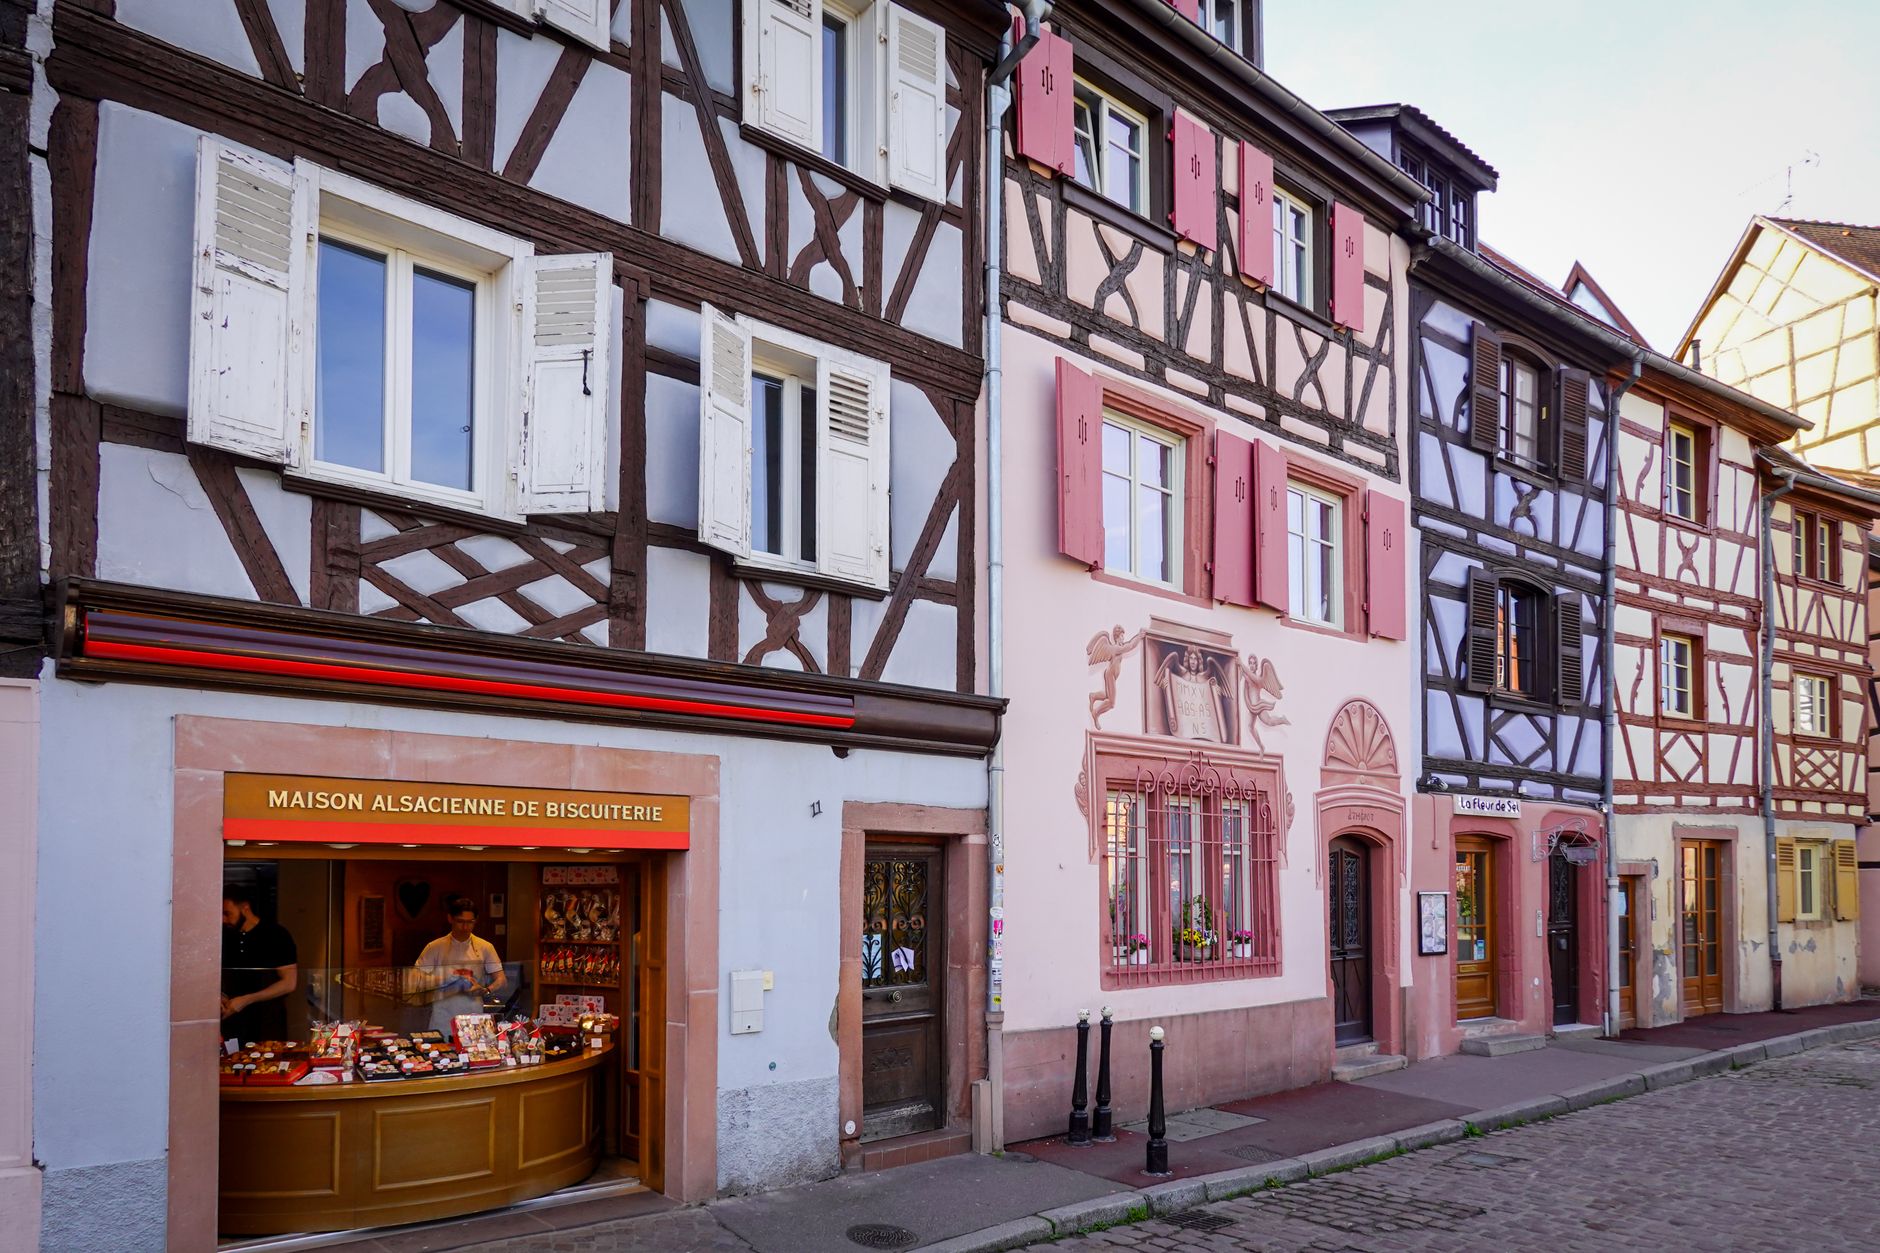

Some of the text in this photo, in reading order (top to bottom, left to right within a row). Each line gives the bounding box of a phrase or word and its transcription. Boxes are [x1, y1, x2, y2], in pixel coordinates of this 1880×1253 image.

[268, 790, 663, 822] MAISON ALSACIENNE DE BISCUITERIE
[1495, 800, 1506, 812] de
[1507, 800, 1520, 813] Sel
